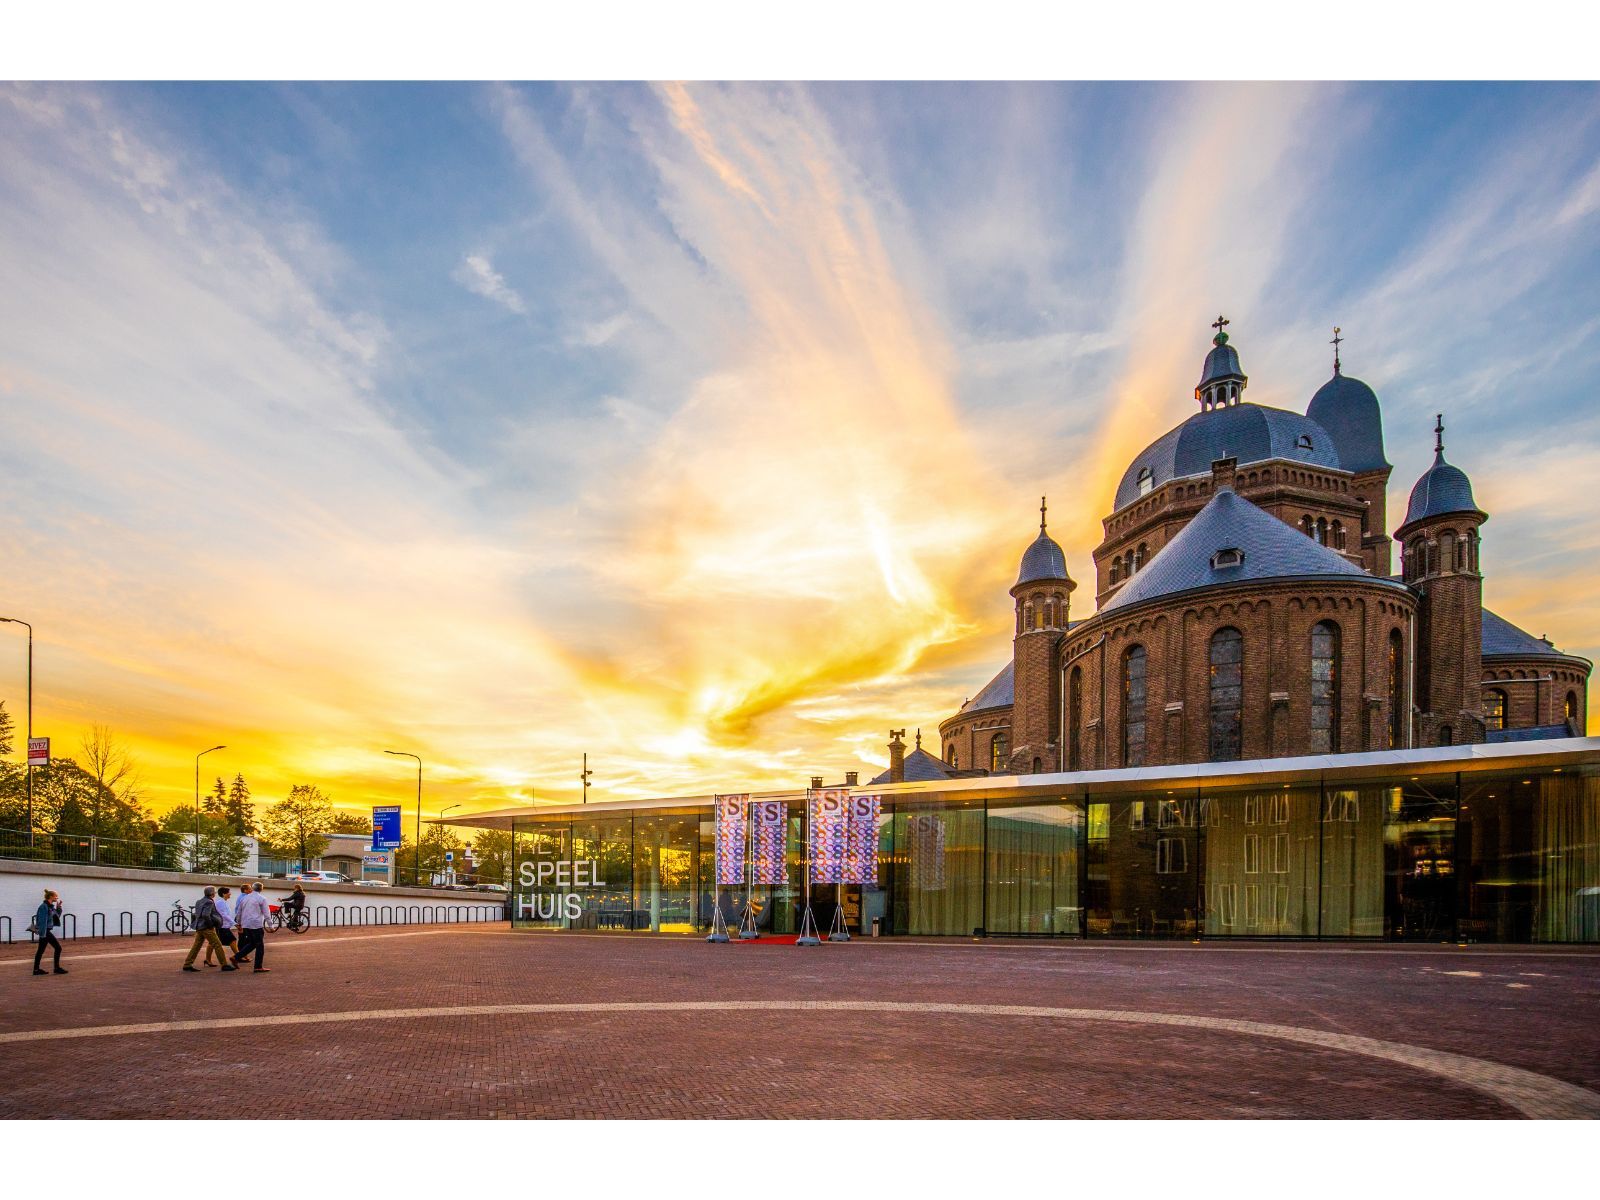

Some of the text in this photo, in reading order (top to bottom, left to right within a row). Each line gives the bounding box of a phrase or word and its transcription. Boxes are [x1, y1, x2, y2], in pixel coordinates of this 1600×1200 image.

[727, 796, 740, 816] S
[823, 791, 839, 811] S
[856, 797, 871, 817] S
[765, 803, 779, 822] S
[519, 860, 606, 887] SPEEL
[518, 893, 582, 920] HUIS
